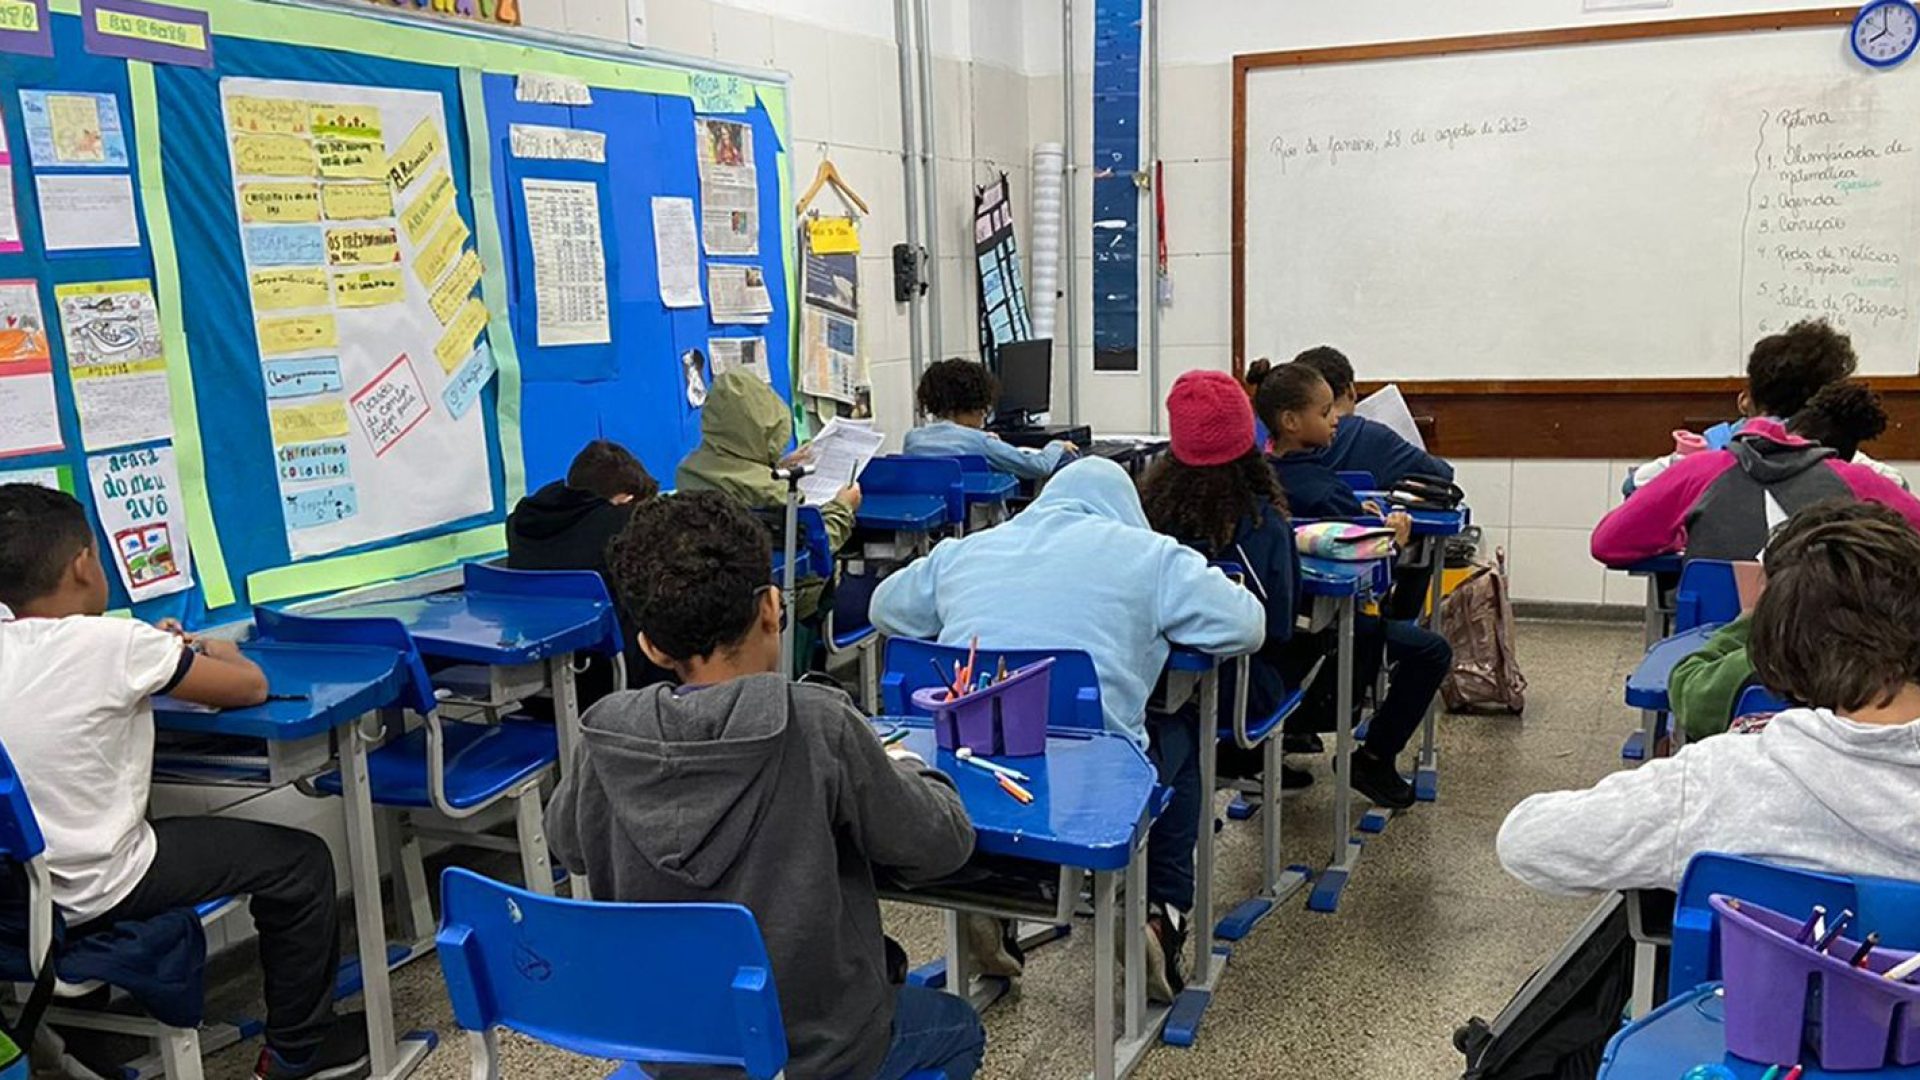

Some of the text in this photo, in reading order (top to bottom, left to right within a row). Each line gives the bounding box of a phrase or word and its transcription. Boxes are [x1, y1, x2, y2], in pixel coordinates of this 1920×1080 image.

[1304, 138, 1320, 154] de
[1411, 128, 1426, 145] de
[1885, 139, 1912, 156] de
[1816, 246, 1836, 260] de
[1822, 294, 1840, 311] de
